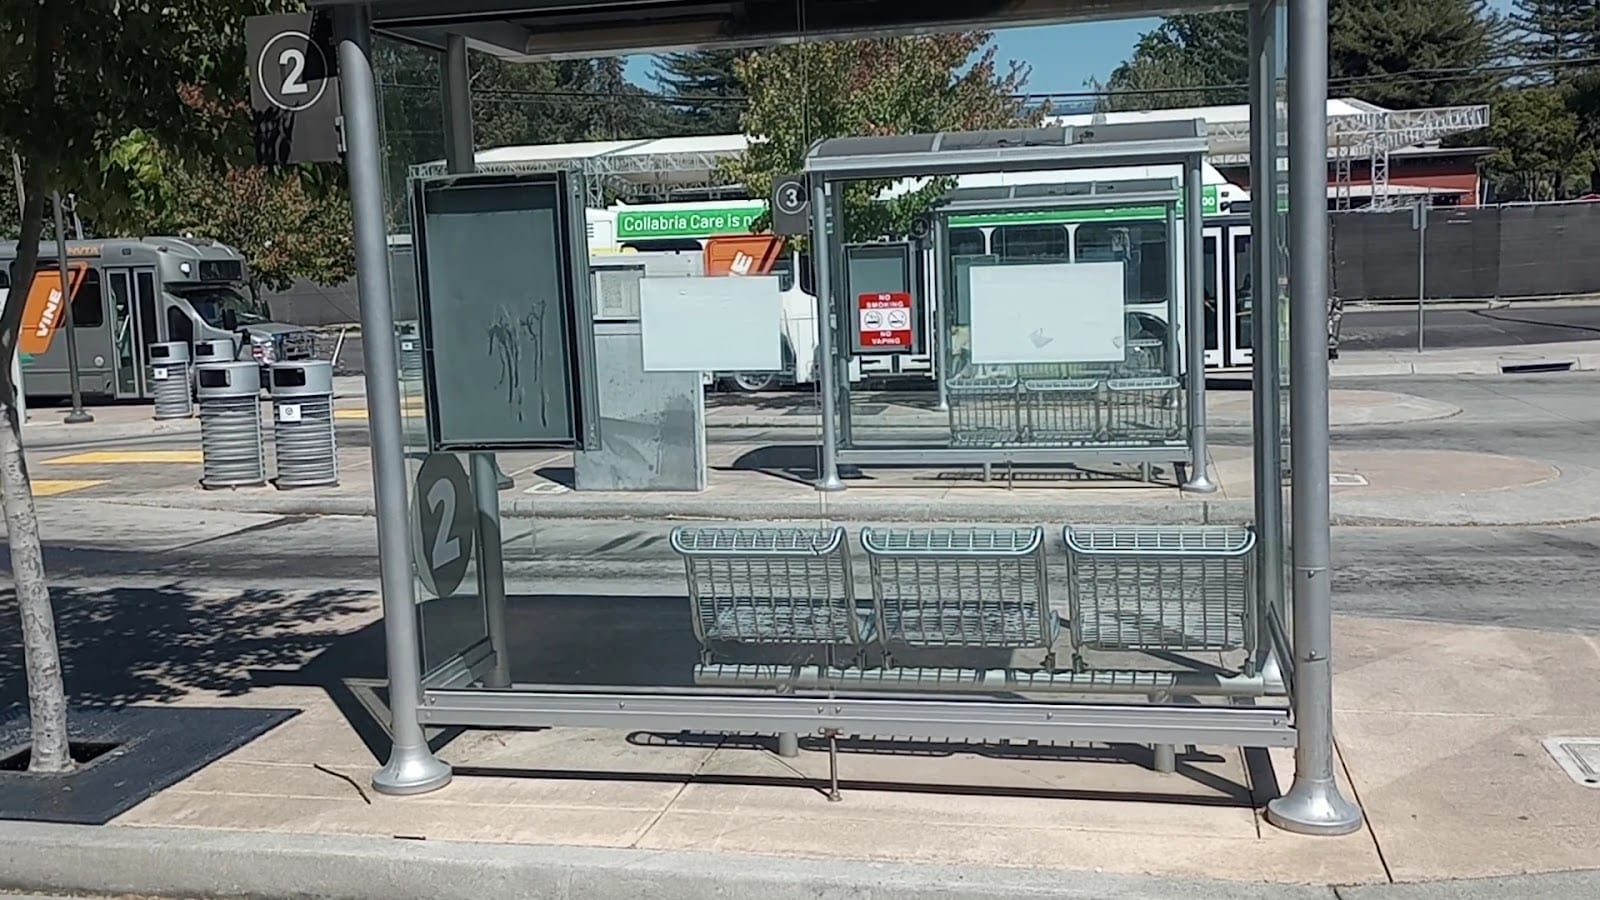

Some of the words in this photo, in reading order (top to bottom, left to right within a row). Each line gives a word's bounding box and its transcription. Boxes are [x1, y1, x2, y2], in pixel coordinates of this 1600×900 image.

[279, 48, 308, 95] 2
[786, 188, 798, 207] 3
[624, 214, 688, 232] Collabria
[690, 213, 724, 229] Care
[727, 213, 740, 228] is
[36, 287, 63, 337] VINE
[426, 477, 461, 571] 2
